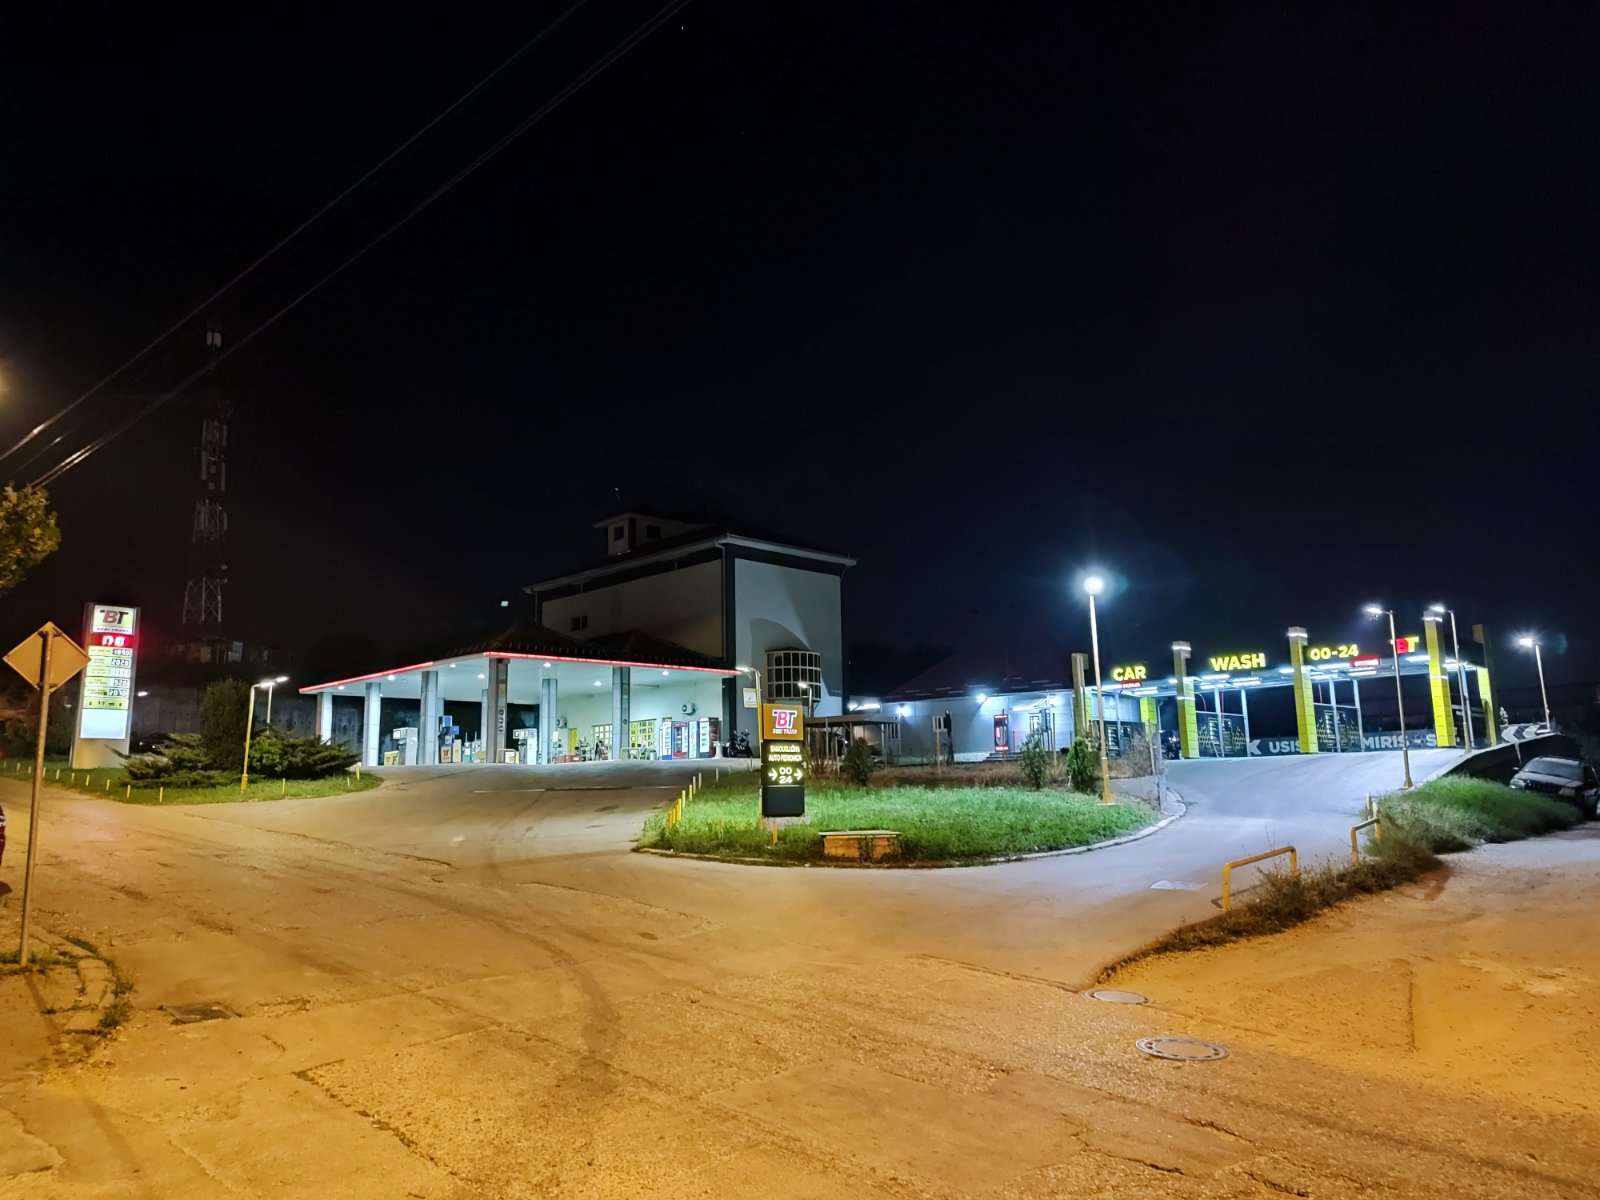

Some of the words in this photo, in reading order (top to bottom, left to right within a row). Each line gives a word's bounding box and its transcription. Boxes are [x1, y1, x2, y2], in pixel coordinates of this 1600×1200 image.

[1112, 665, 1147, 682] CAR
[1209, 653, 1266, 671] WASH
[1310, 643, 1360, 660] 00-24
[779, 766, 793, 775] 00
[779, 776, 793, 784] 24
